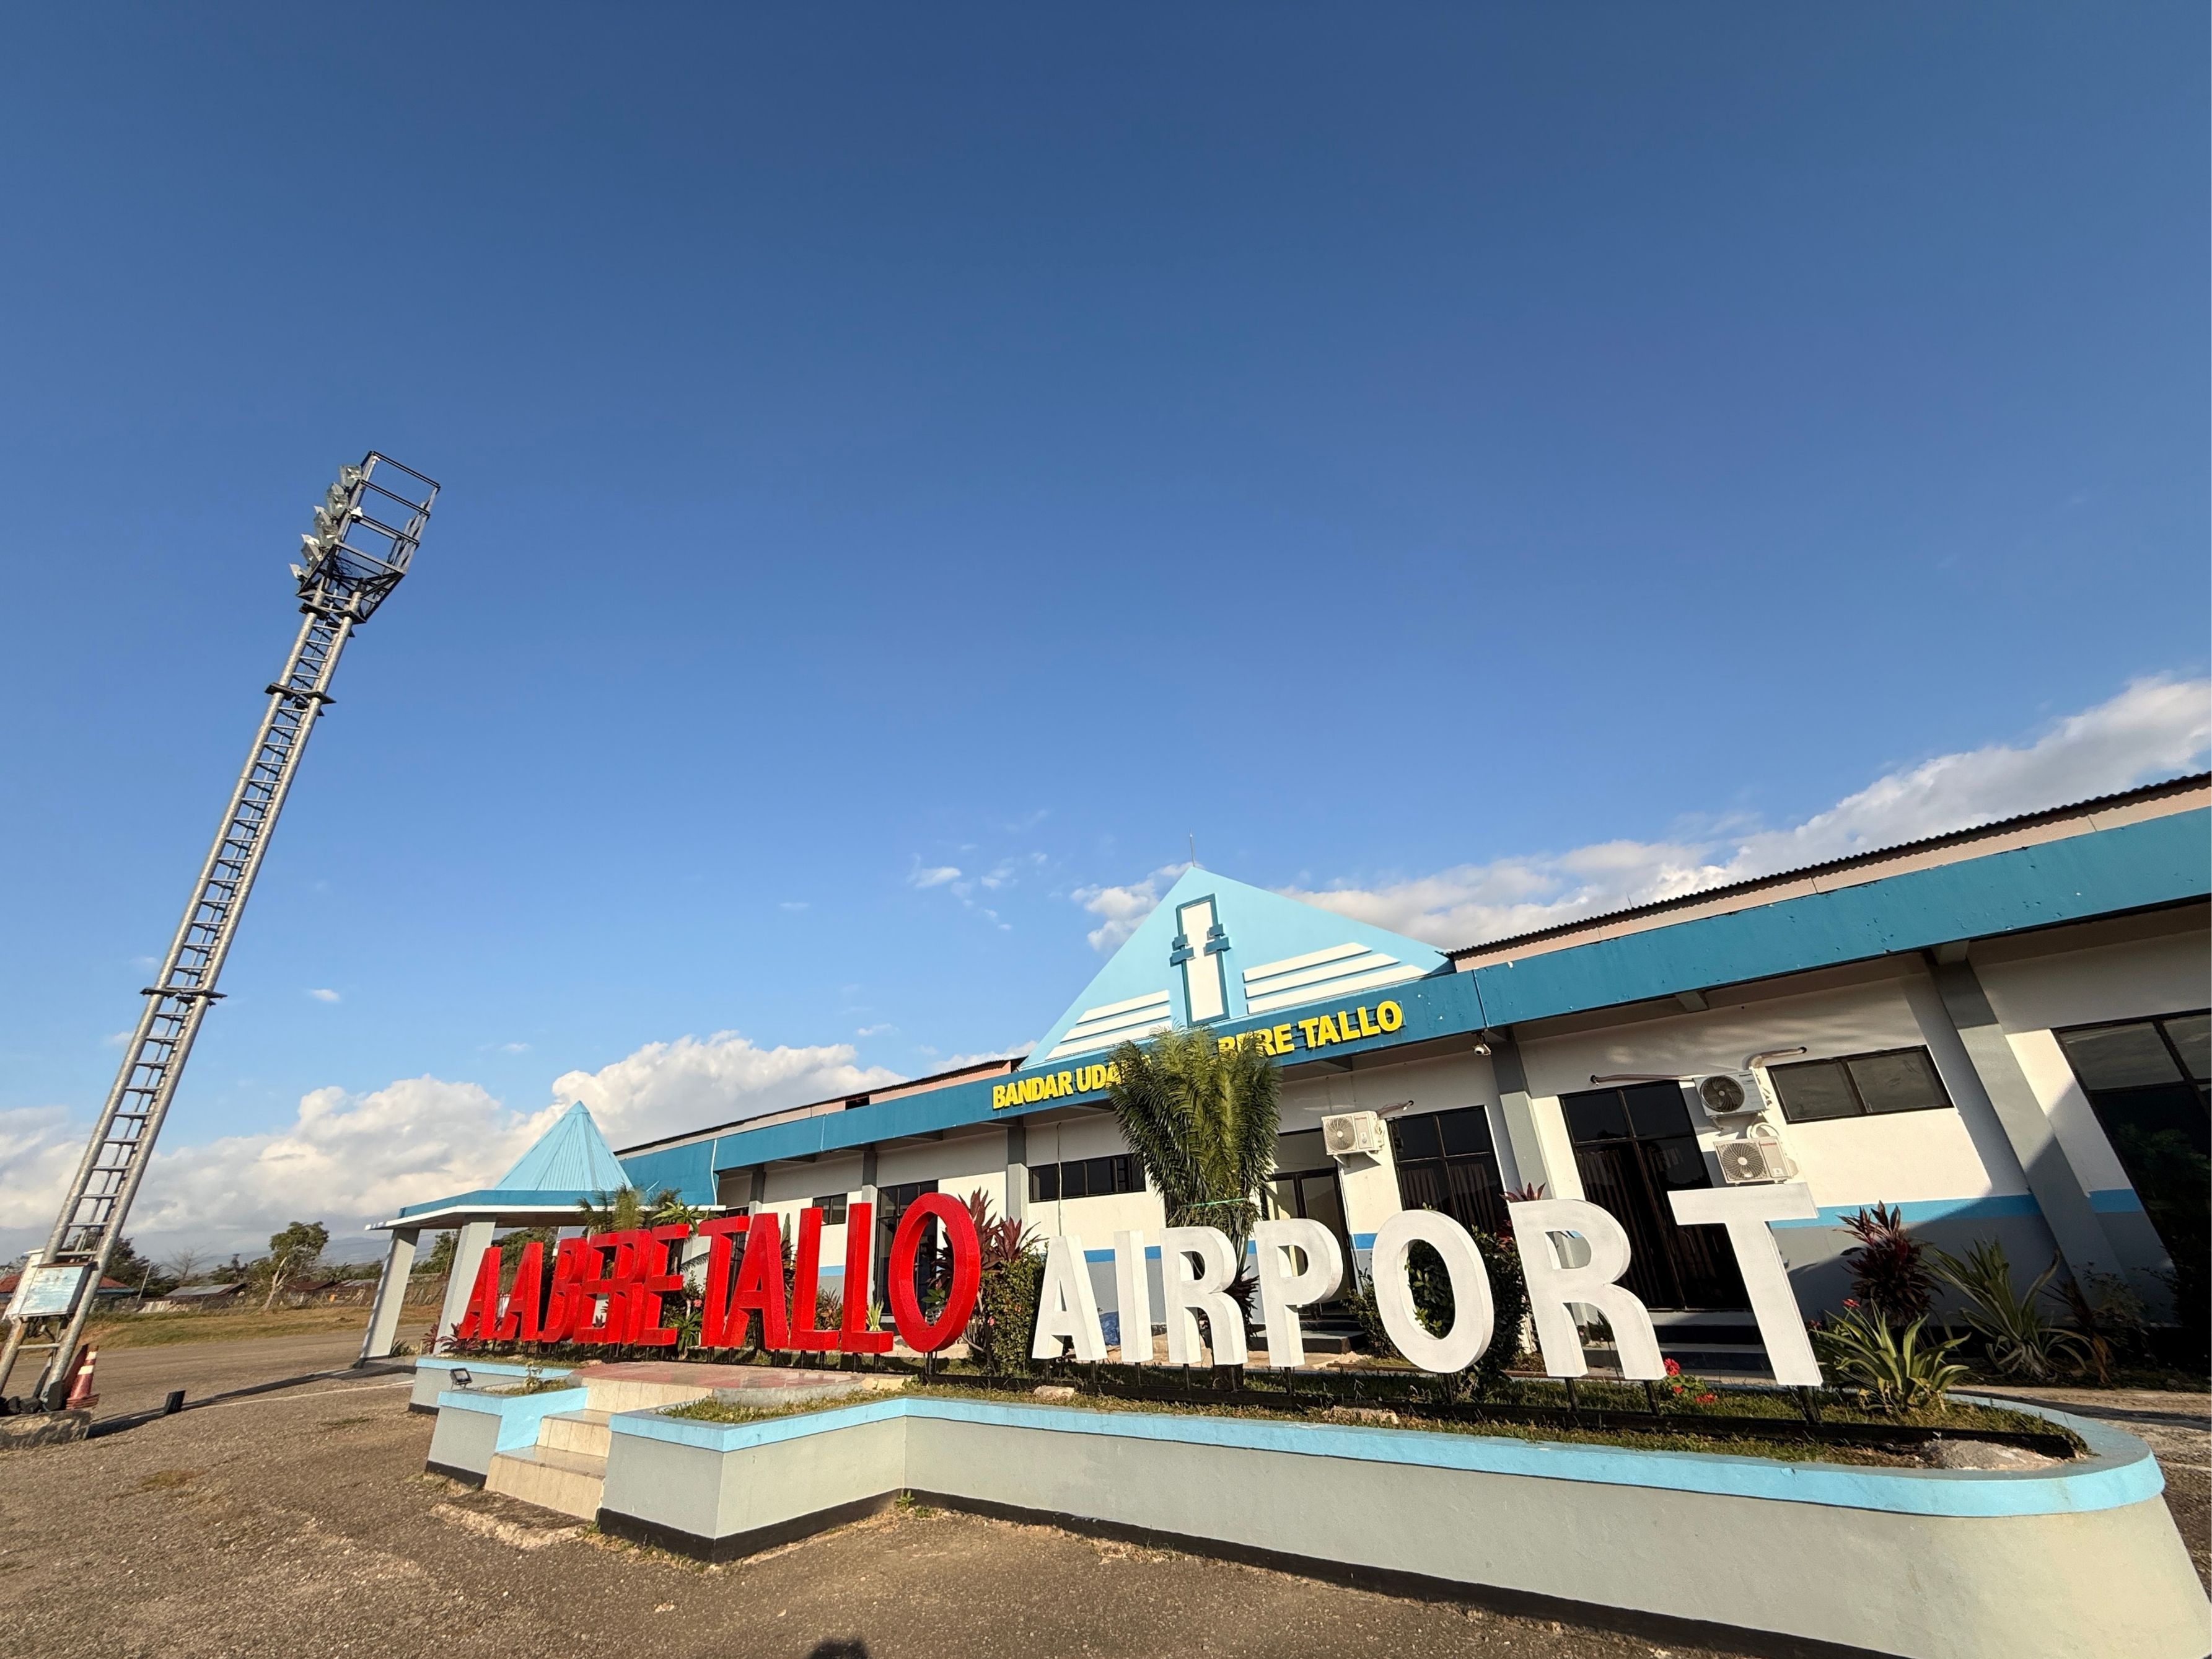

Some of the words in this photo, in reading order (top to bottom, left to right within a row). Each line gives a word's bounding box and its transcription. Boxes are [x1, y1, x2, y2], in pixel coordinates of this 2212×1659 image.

[993, 1071, 1074, 1109] BANDAR
[1076, 1054, 1152, 1093] UDA
[1298, 1000, 1403, 1049] TALLO
[699, 1192, 981, 1353] TALLO
[1032, 1182, 1824, 1387] AIRPORT
